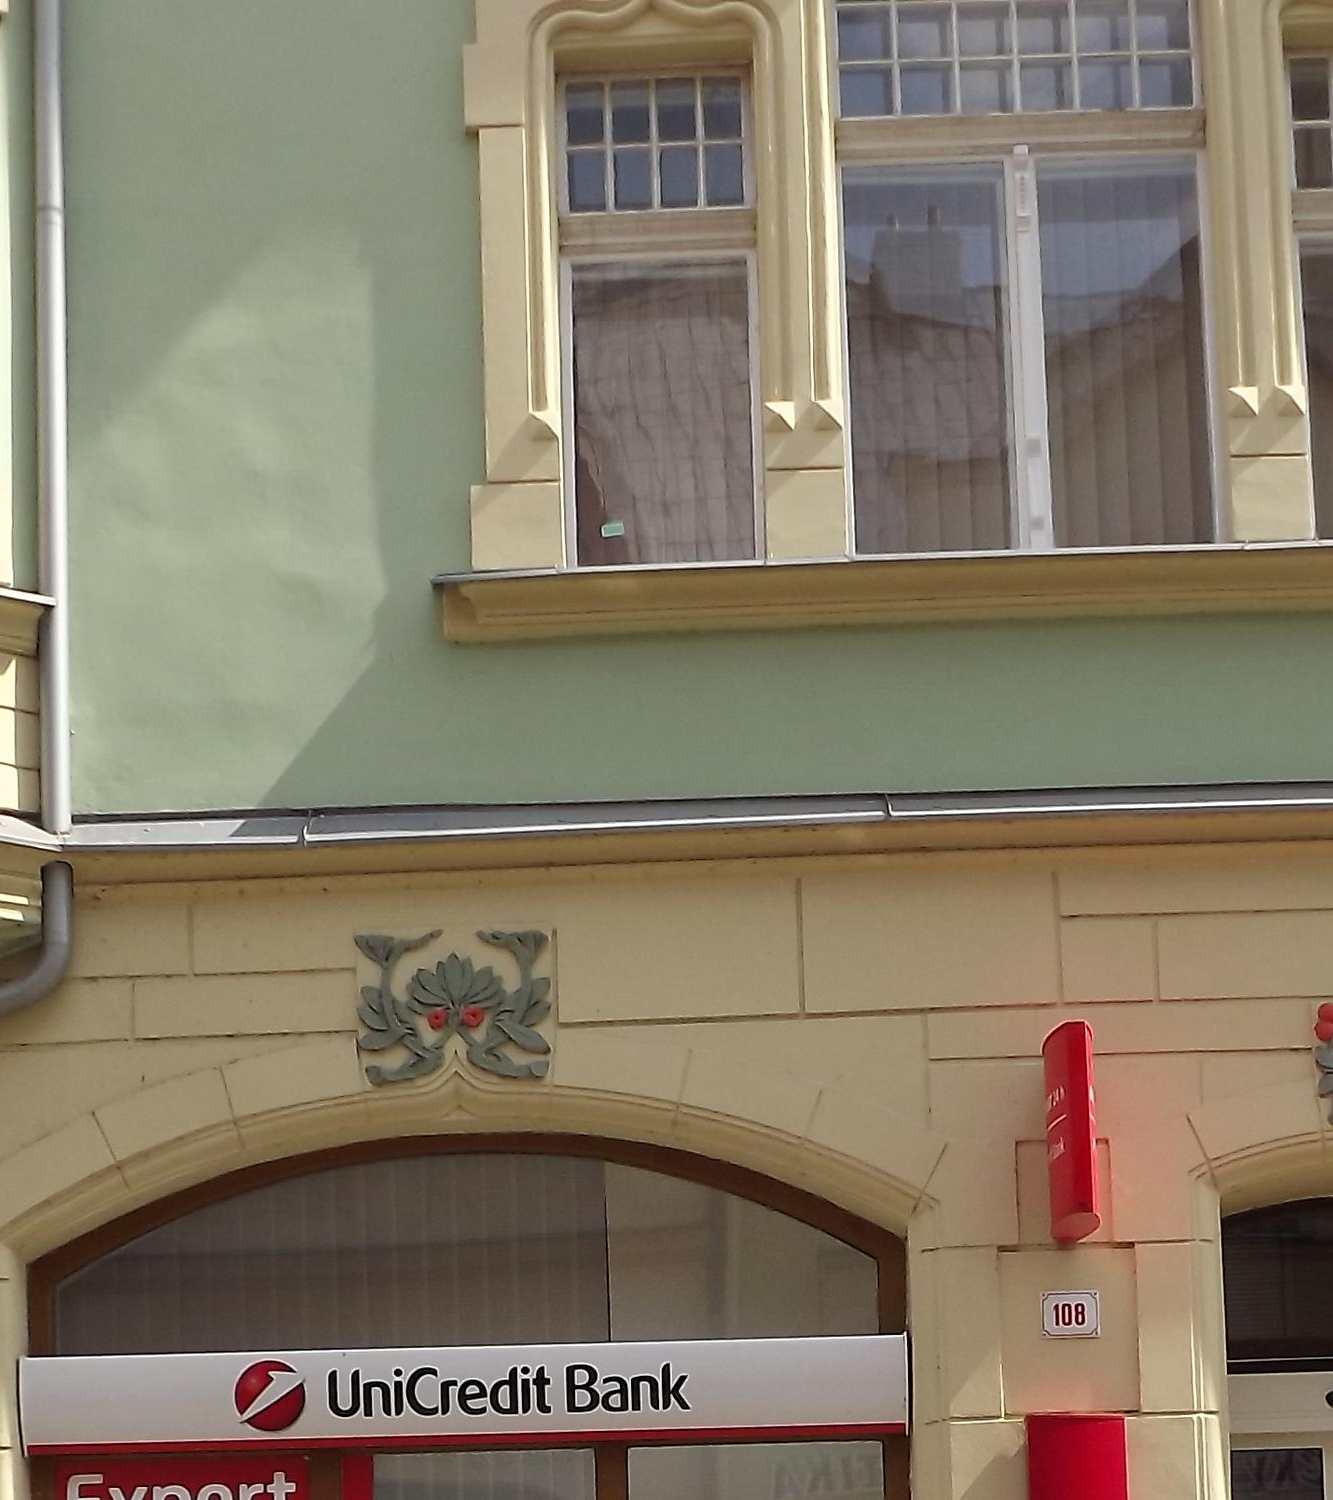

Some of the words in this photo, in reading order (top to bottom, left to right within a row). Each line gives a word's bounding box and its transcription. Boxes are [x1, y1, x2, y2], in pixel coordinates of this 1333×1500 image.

[1053, 1303, 1086, 1327] 108
[327, 1366, 552, 1418] UniCredit
[565, 1362, 691, 1413] Bank
